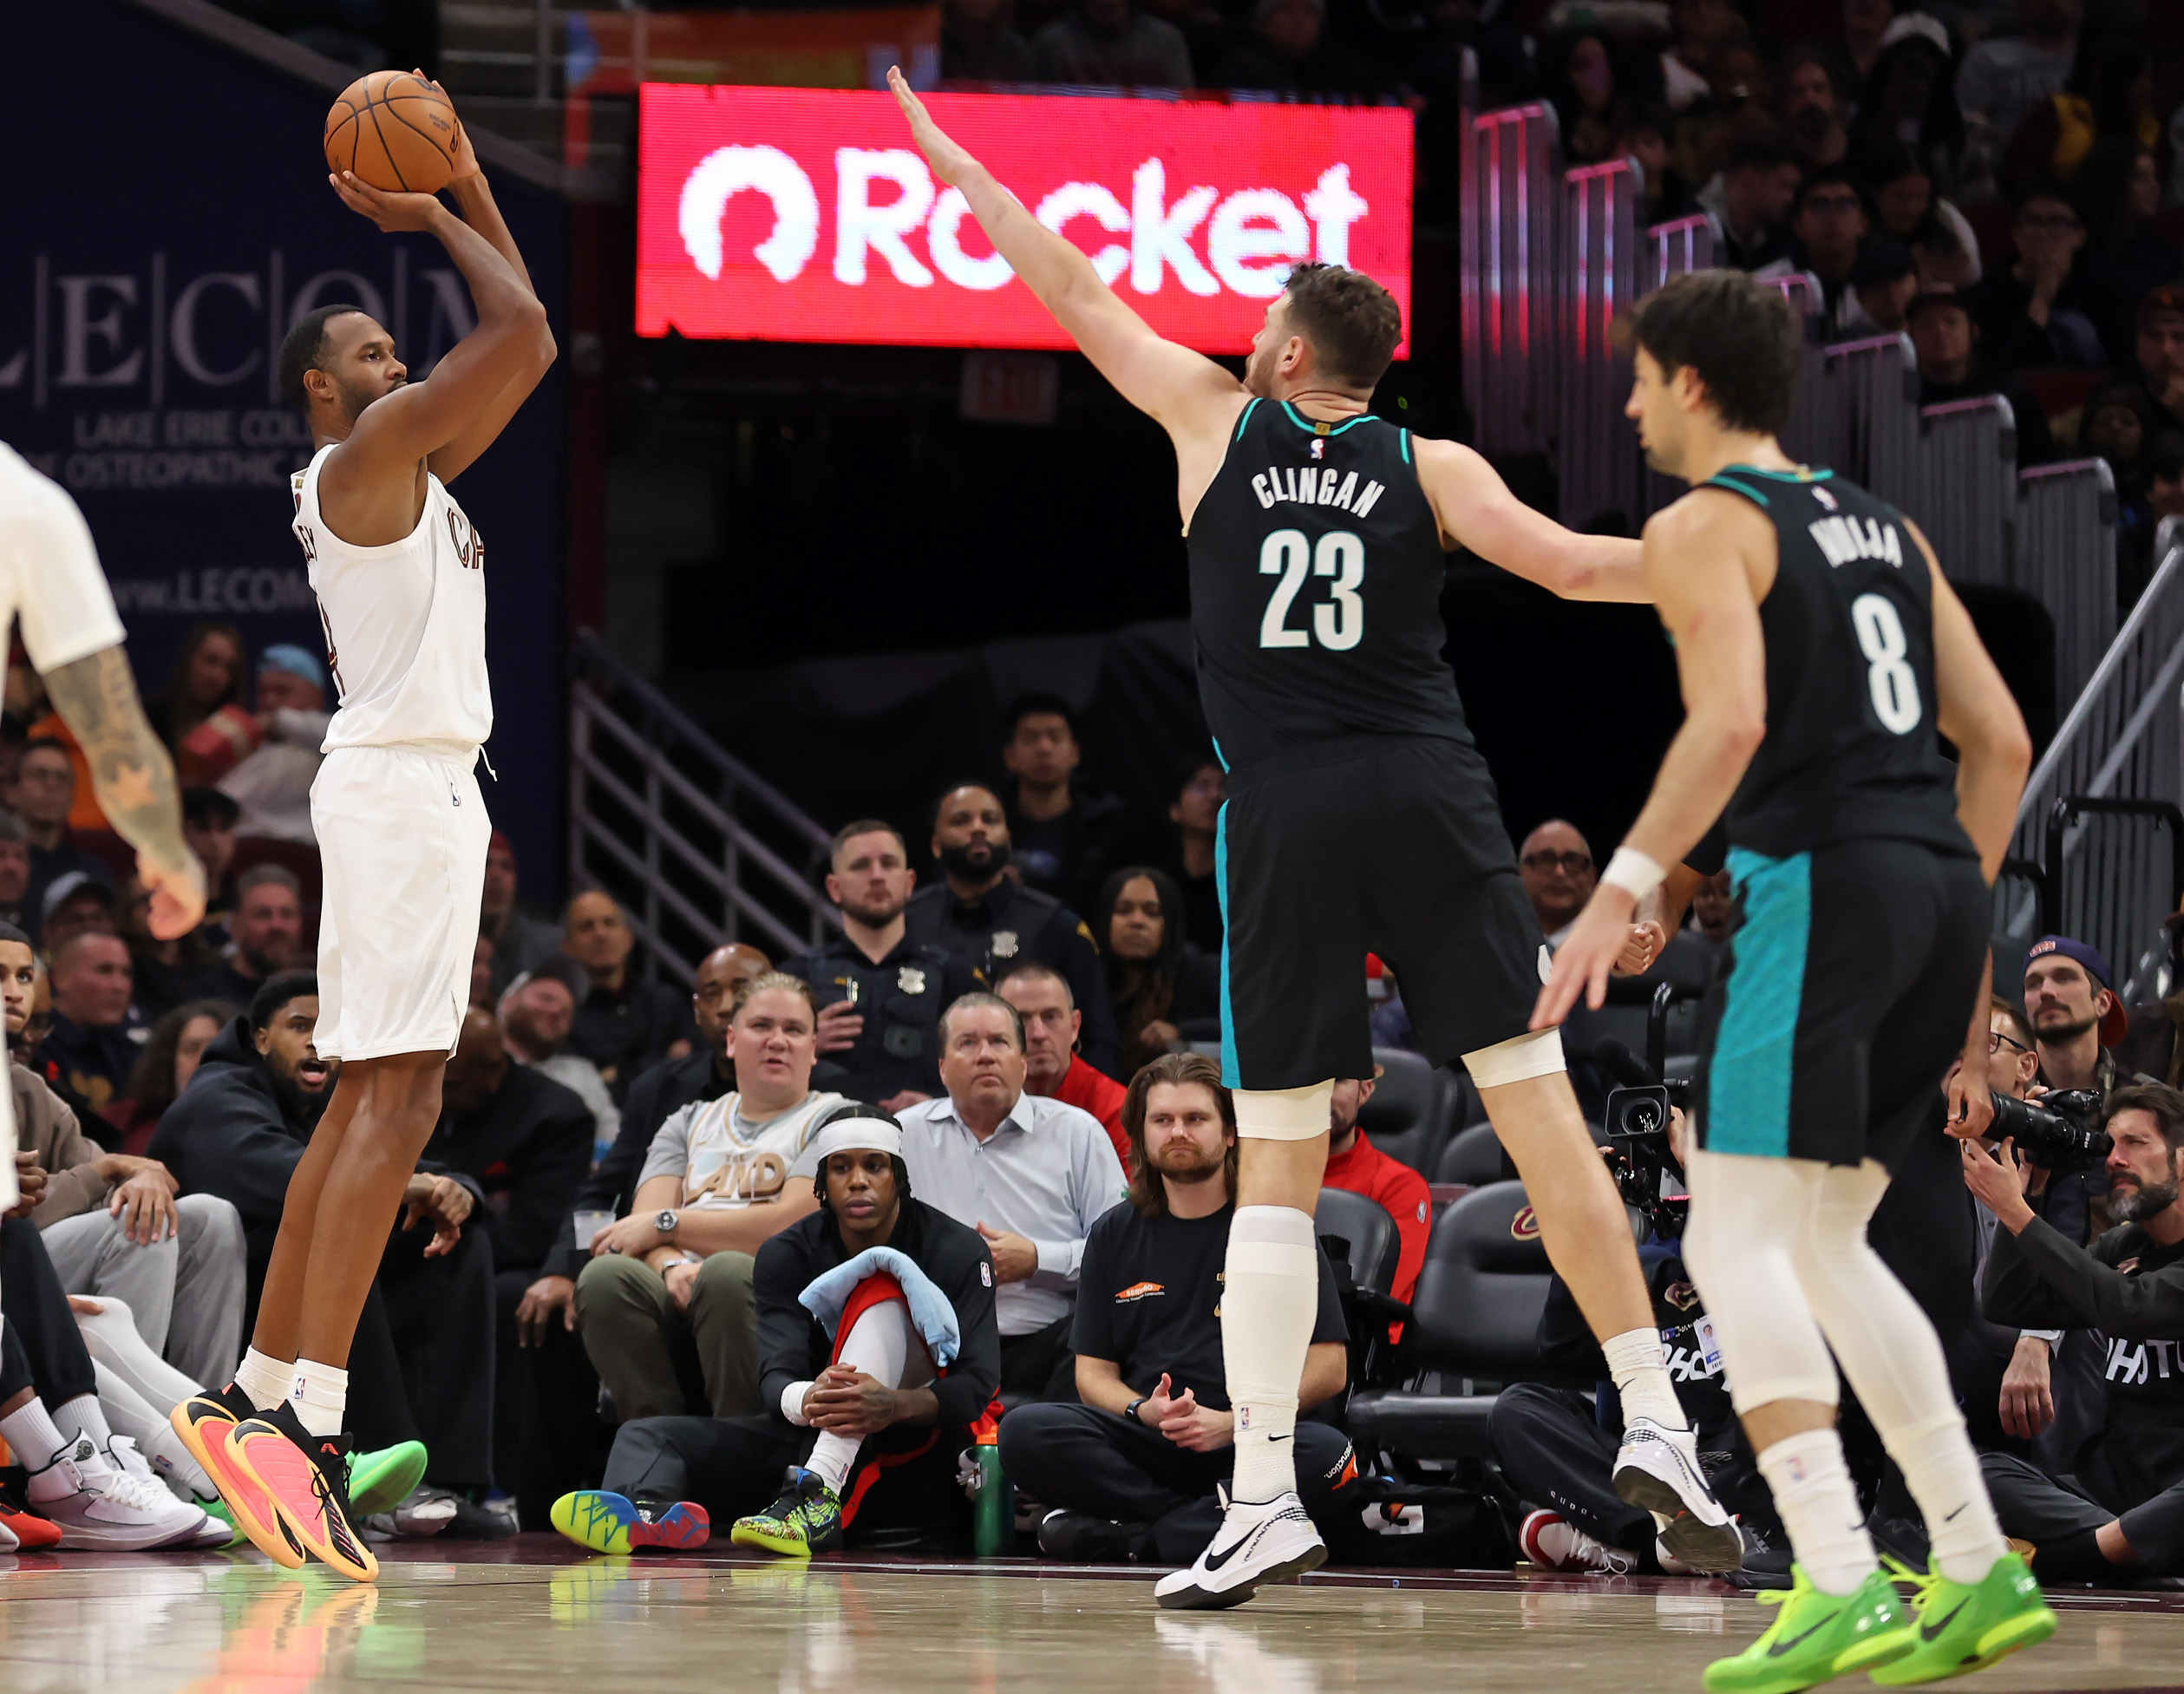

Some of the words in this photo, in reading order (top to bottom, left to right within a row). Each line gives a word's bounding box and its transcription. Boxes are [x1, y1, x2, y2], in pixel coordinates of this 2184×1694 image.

[834, 146, 1368, 297] Rocket
[75, 411, 154, 448] LAKE
[163, 409, 231, 447] ERIE
[1251, 467, 1384, 520] CLINGAN
[1259, 527, 1365, 651] 23
[1852, 593, 1921, 735] 8
[1126, 1284, 1154, 1297] SERVRO
